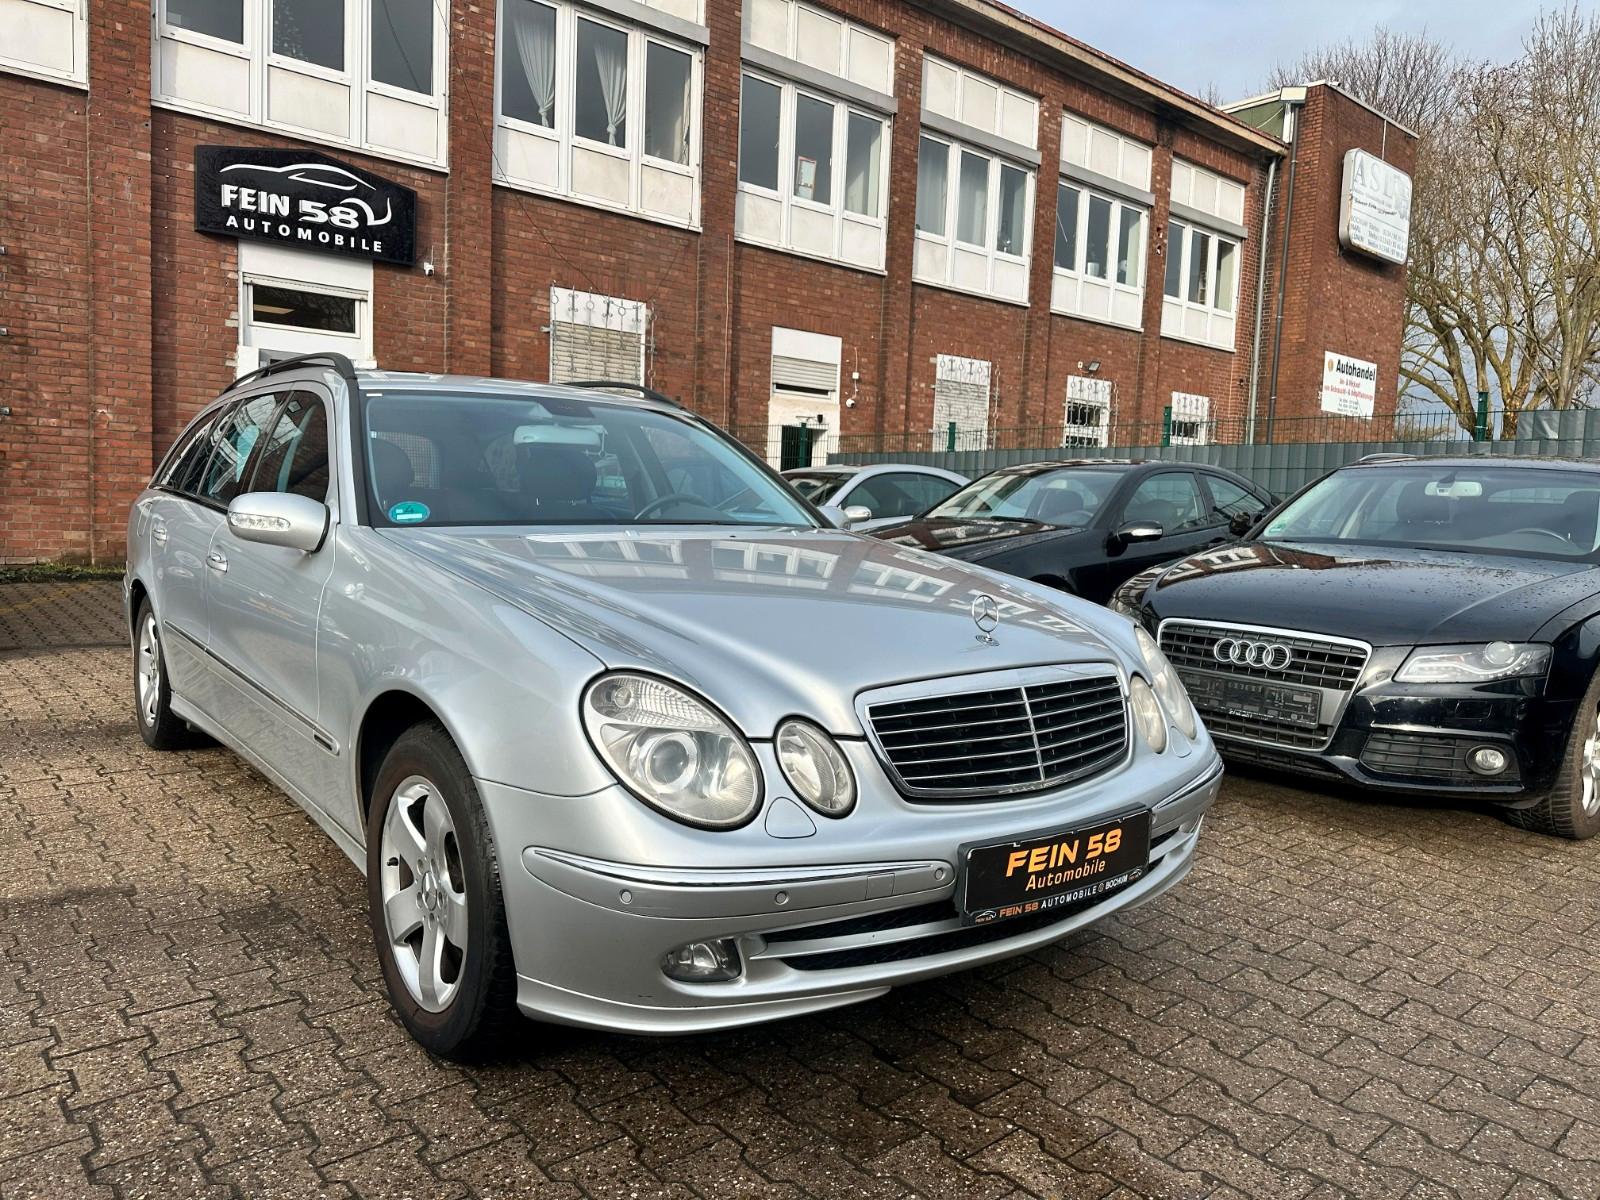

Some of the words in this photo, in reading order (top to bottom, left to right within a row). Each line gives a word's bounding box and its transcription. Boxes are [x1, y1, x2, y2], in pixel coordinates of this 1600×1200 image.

[220, 183, 290, 217] FEIN
[299, 199, 360, 229] 58
[226, 215, 383, 253] AUTOMOBILE
[1336, 359, 1375, 381] Autohandel
[1005, 839, 1079, 878] FEIN
[1085, 828, 1122, 860] 58
[1000, 904, 1023, 918] FEIN
[1024, 902, 1040, 915] 58
[1041, 884, 1097, 909] AUTOMOBILE
[1105, 873, 1128, 890] BOCHUM
[1025, 859, 1106, 891] Automobile
